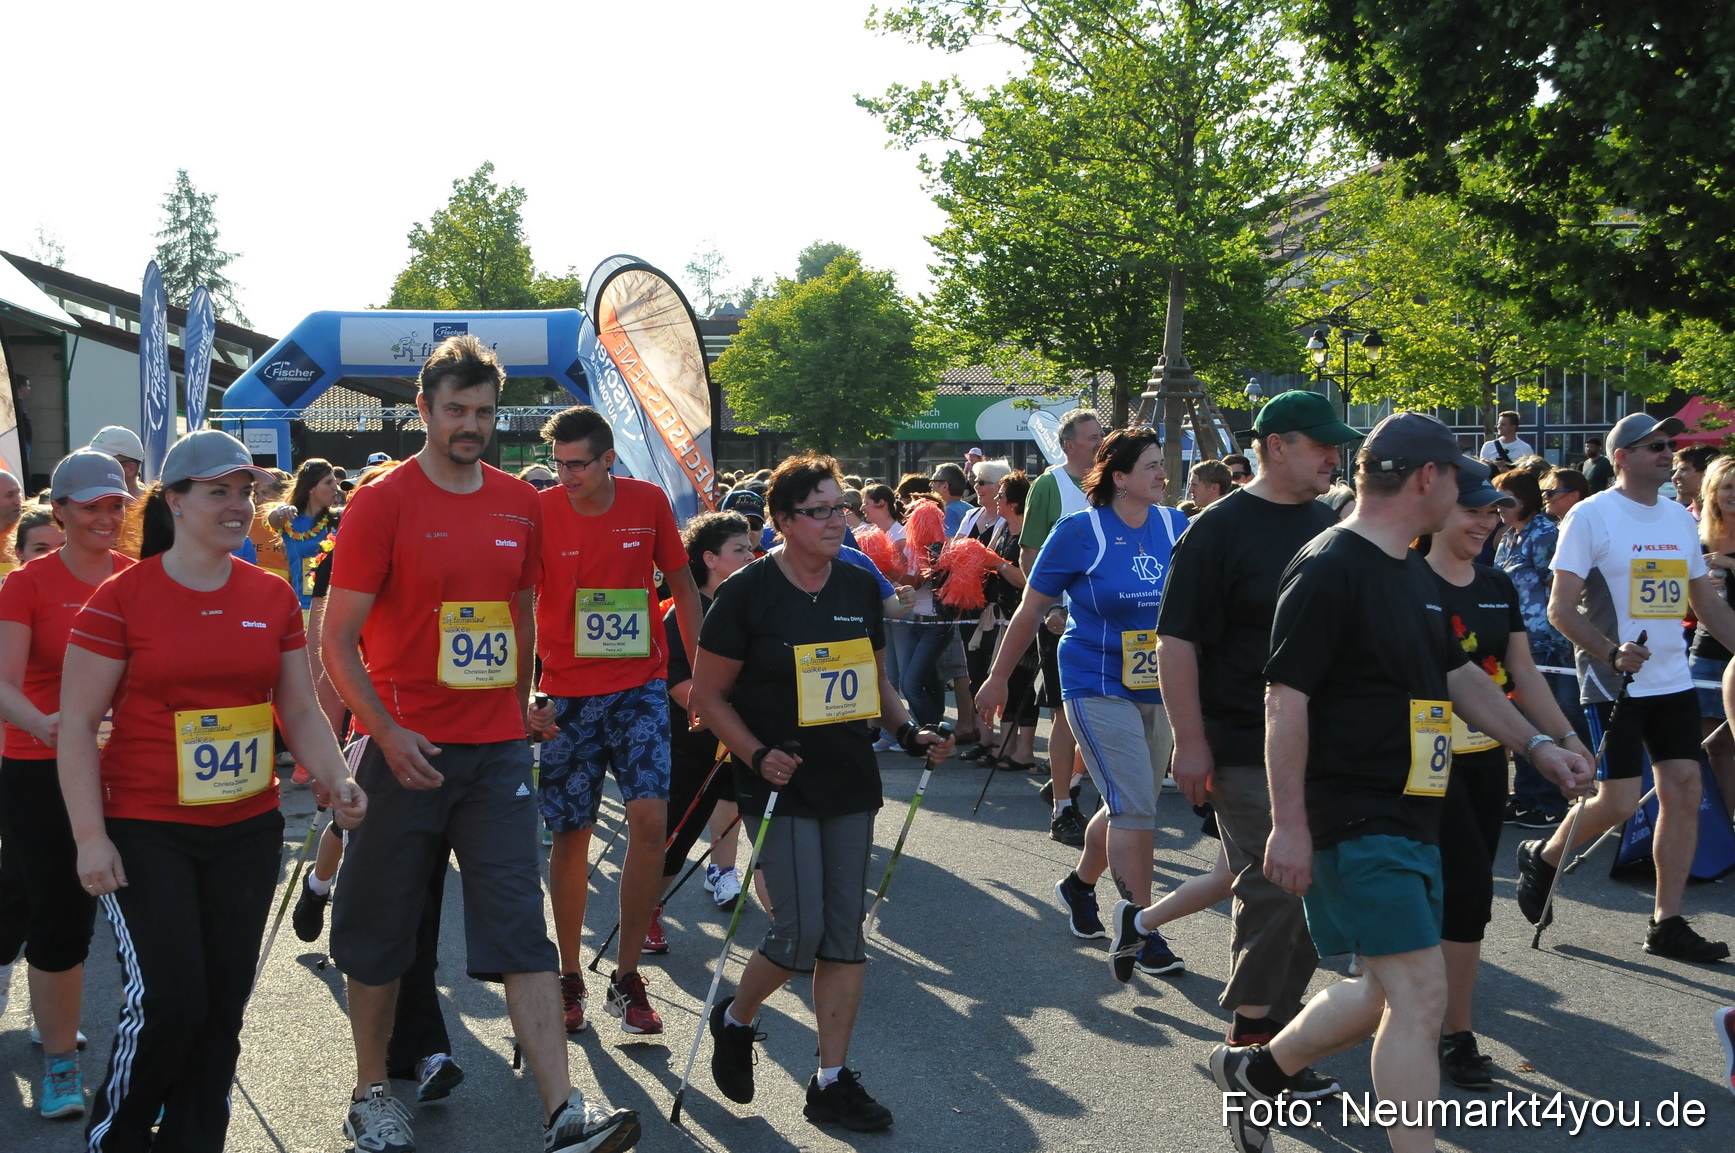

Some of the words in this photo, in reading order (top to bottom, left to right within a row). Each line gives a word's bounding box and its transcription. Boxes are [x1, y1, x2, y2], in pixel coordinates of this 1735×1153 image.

[440, 328, 467, 336] Fischer
[150, 289, 161, 409] Fischer
[272, 366, 315, 378] Fischer
[1639, 579, 1681, 604] 519
[586, 613, 640, 641] 934
[451, 632, 508, 668] 943
[820, 669, 859, 703] 70
[194, 737, 259, 781] 941
